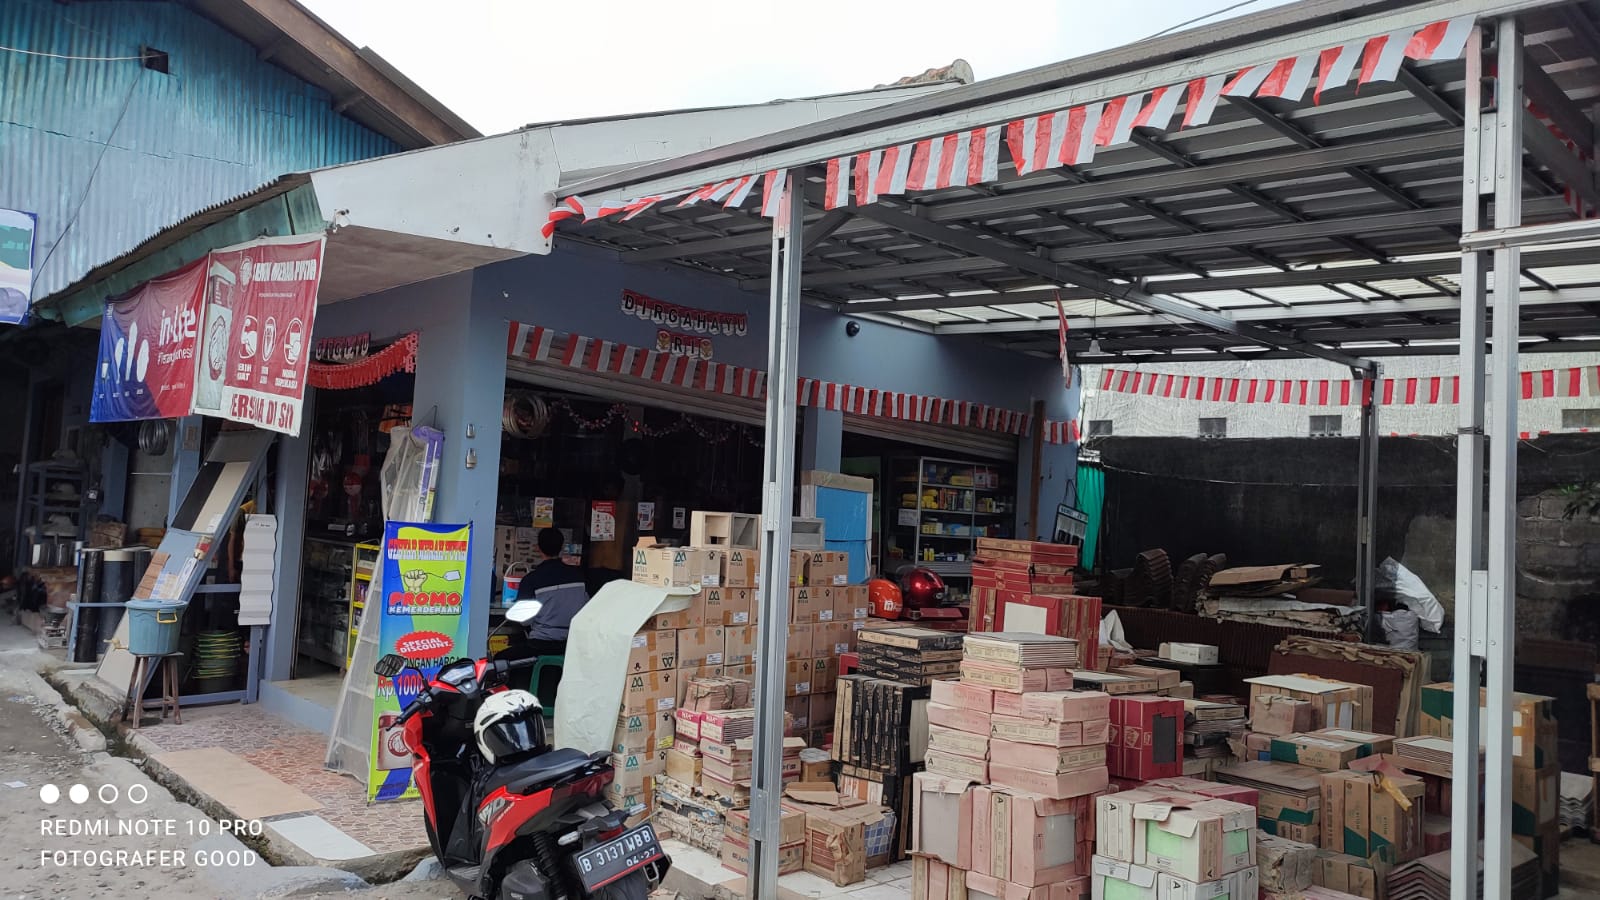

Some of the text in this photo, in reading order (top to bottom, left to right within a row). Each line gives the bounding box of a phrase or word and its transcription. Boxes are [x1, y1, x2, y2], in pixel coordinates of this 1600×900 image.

[624, 294, 746, 333] DIRGAHAYU
[674, 337, 695, 352] RI
[388, 591, 462, 606] PROMO
[388, 606, 460, 615] KEMERDEKAAN
[402, 636, 442, 648] SPECIAL
[582, 830, 651, 872] B 3137 WBB
